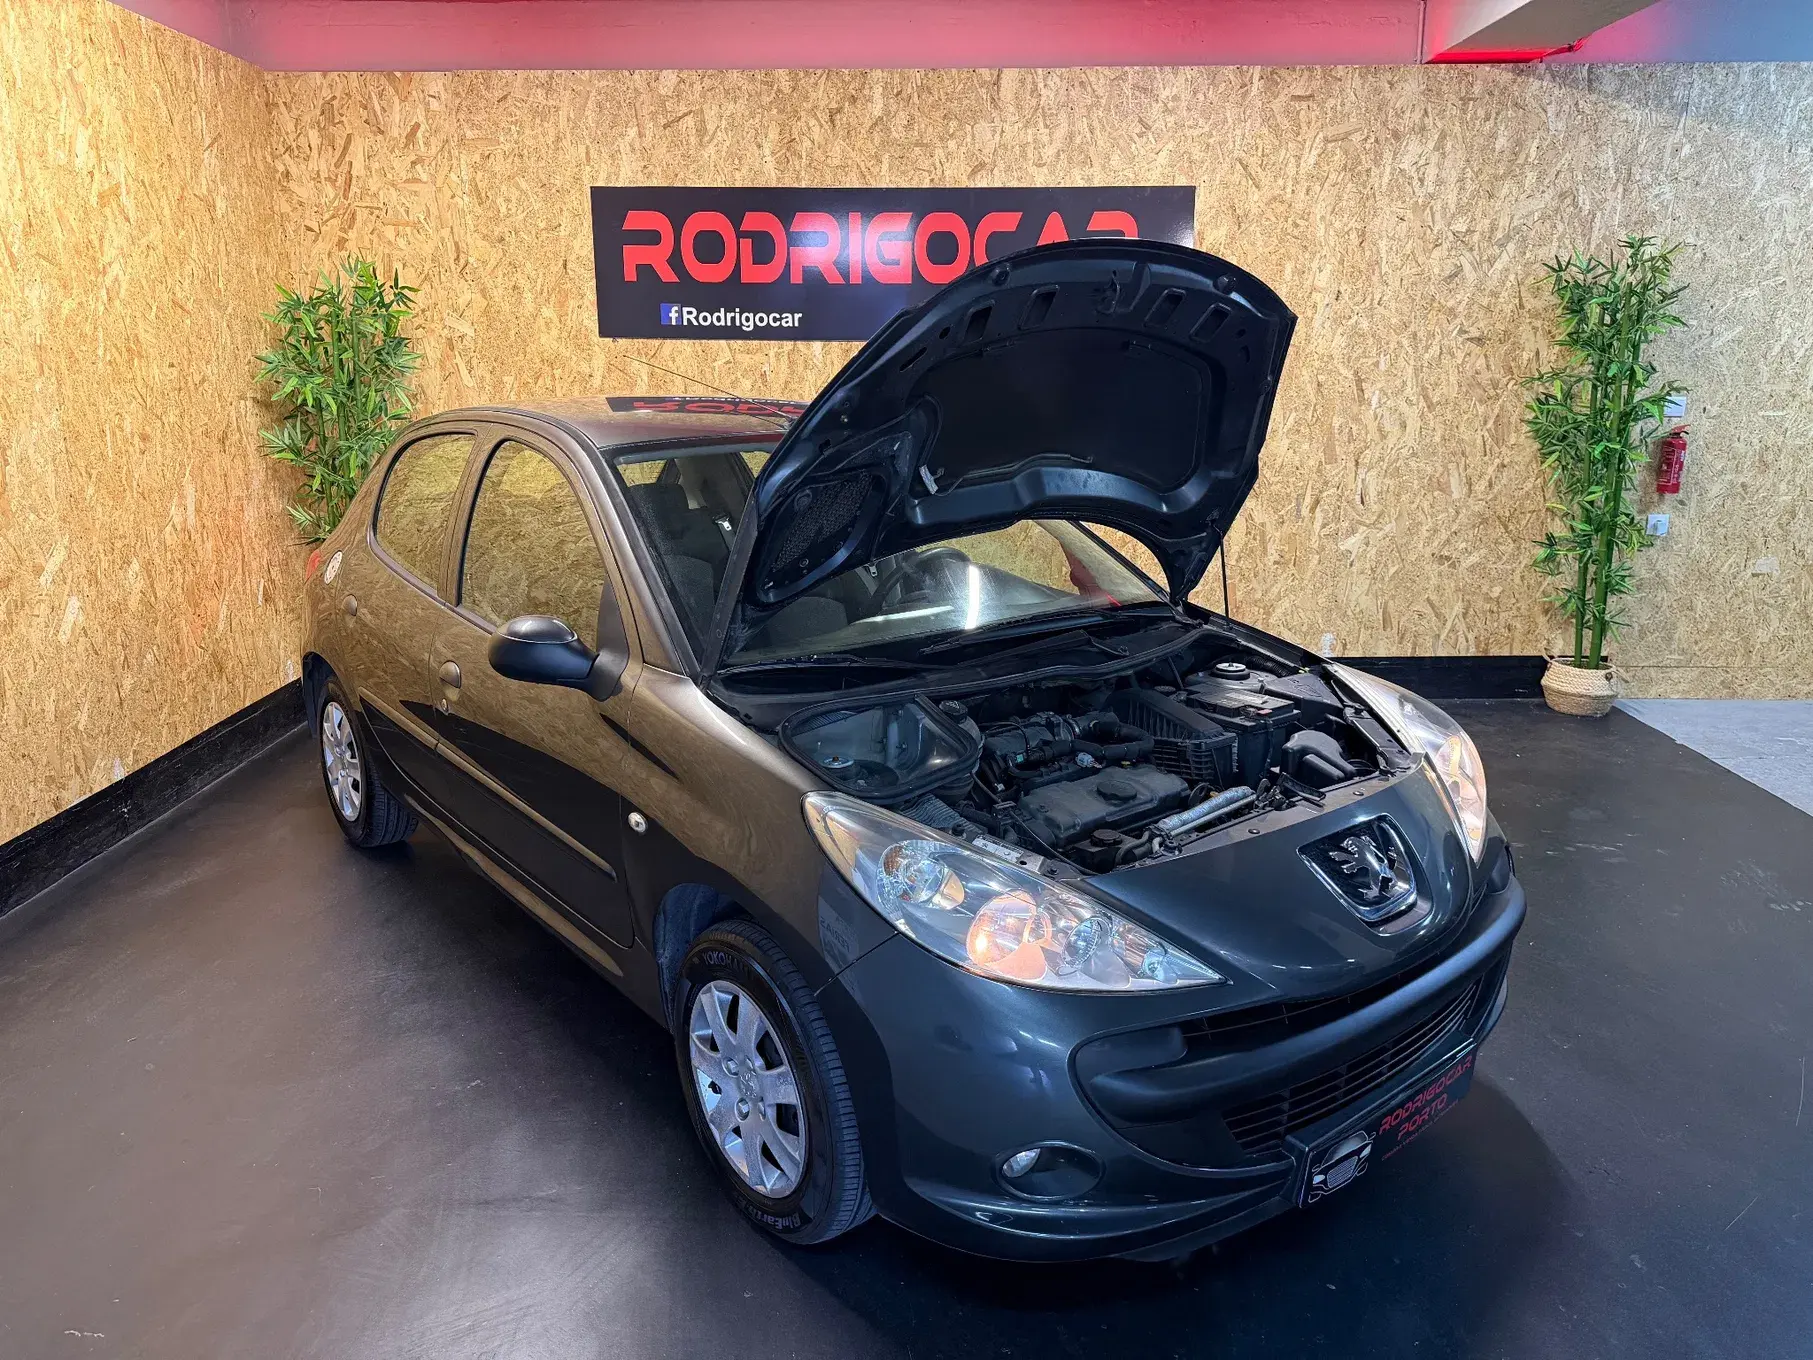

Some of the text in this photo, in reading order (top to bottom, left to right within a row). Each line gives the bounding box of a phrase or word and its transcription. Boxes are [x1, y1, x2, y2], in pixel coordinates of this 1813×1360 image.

[682, 306, 803, 331] Rodrigocar
[1378, 1055, 1473, 1135] RODRIGOCAR
[1397, 1093, 1448, 1140] PORTO
